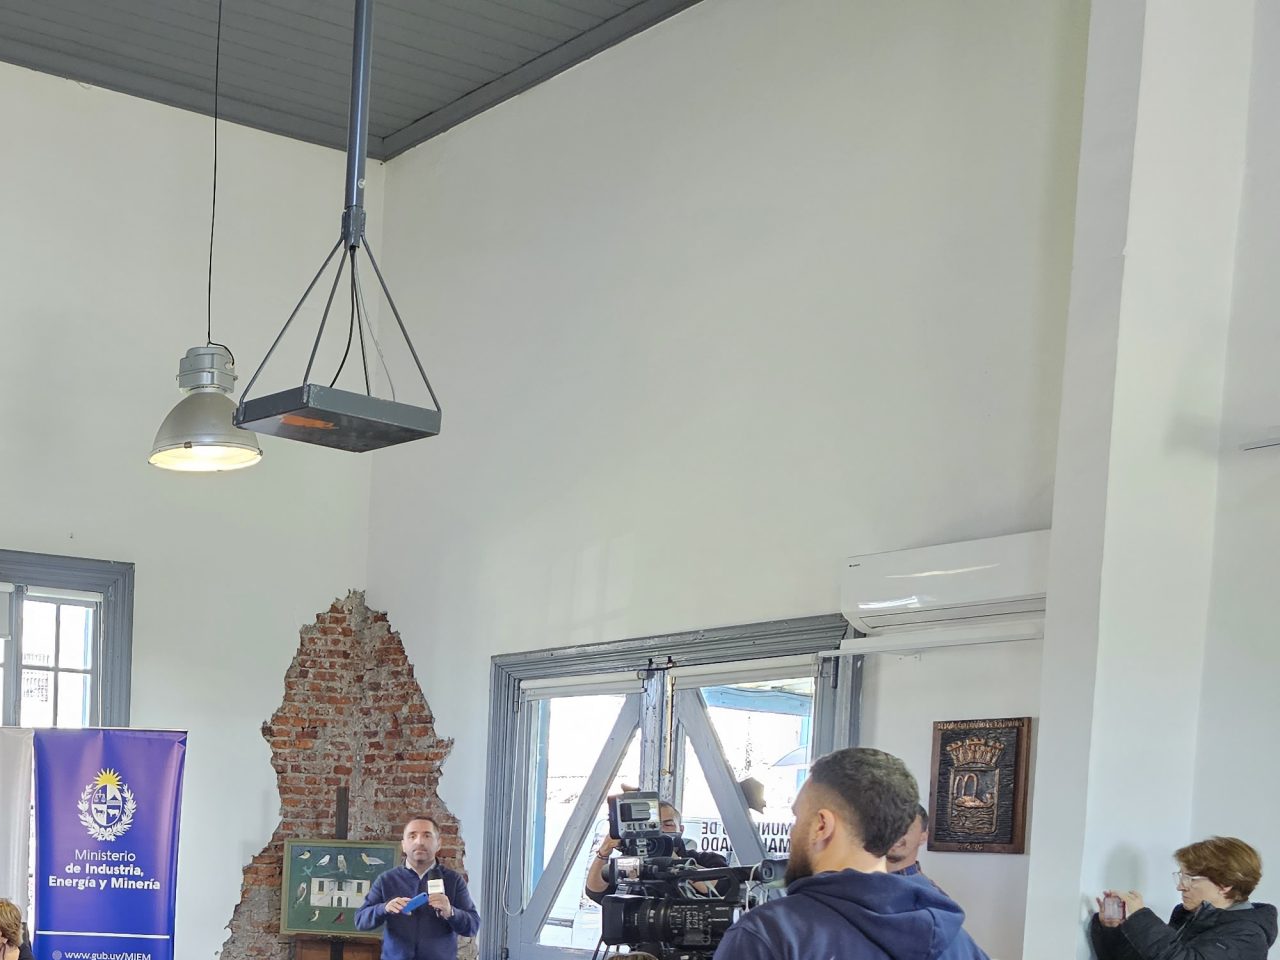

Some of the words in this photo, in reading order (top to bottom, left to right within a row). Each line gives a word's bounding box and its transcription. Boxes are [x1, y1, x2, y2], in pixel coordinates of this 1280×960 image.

[75, 849, 136, 861] Ministerio
[65, 863, 81, 874] de
[85, 864, 144, 877] Industria,
[48, 876, 96, 890] Energía
[99, 879, 107, 890] y
[111, 877, 161, 890] Minería
